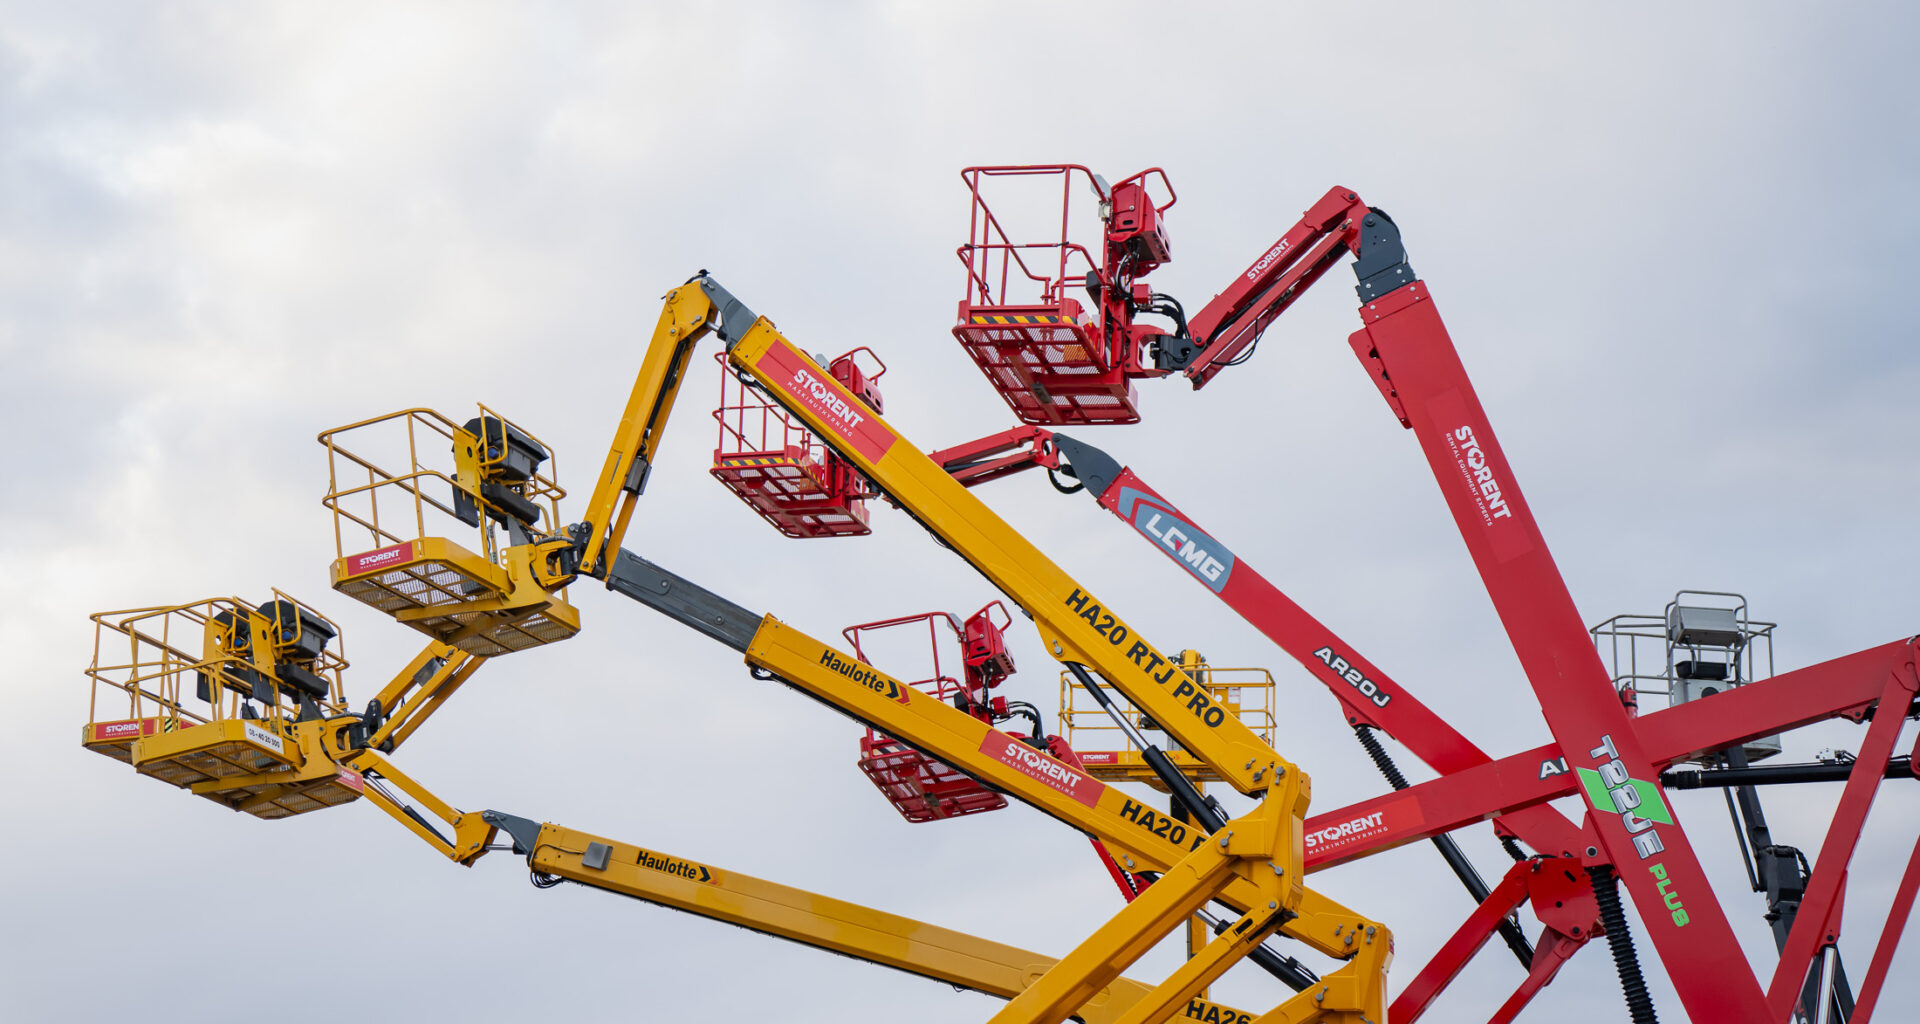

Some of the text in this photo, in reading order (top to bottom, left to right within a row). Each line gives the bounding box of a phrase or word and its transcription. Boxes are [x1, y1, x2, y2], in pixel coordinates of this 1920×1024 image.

[1246, 237, 1290, 280] STORENT
[793, 368, 865, 429] STORENT
[1445, 432, 1493, 527] RENTAL EQUIPMENT EXPERTS
[1454, 425, 1512, 519] STORENT
[359, 549, 401, 566] STORENT
[1145, 513, 1225, 582] LCMG
[819, 649, 885, 693] Haulotte
[1064, 588, 1225, 729] HA20 RTJ PRO
[1312, 645, 1392, 709] AR20J
[105, 722, 144, 733] STOREN
[1005, 743, 1082, 788] STORENT
[1119, 799, 1187, 845] HA20
[1304, 811, 1383, 848] STORENT
[1589, 733, 1691, 928] T22JE PLUS
[636, 850, 697, 879] Haulotte
